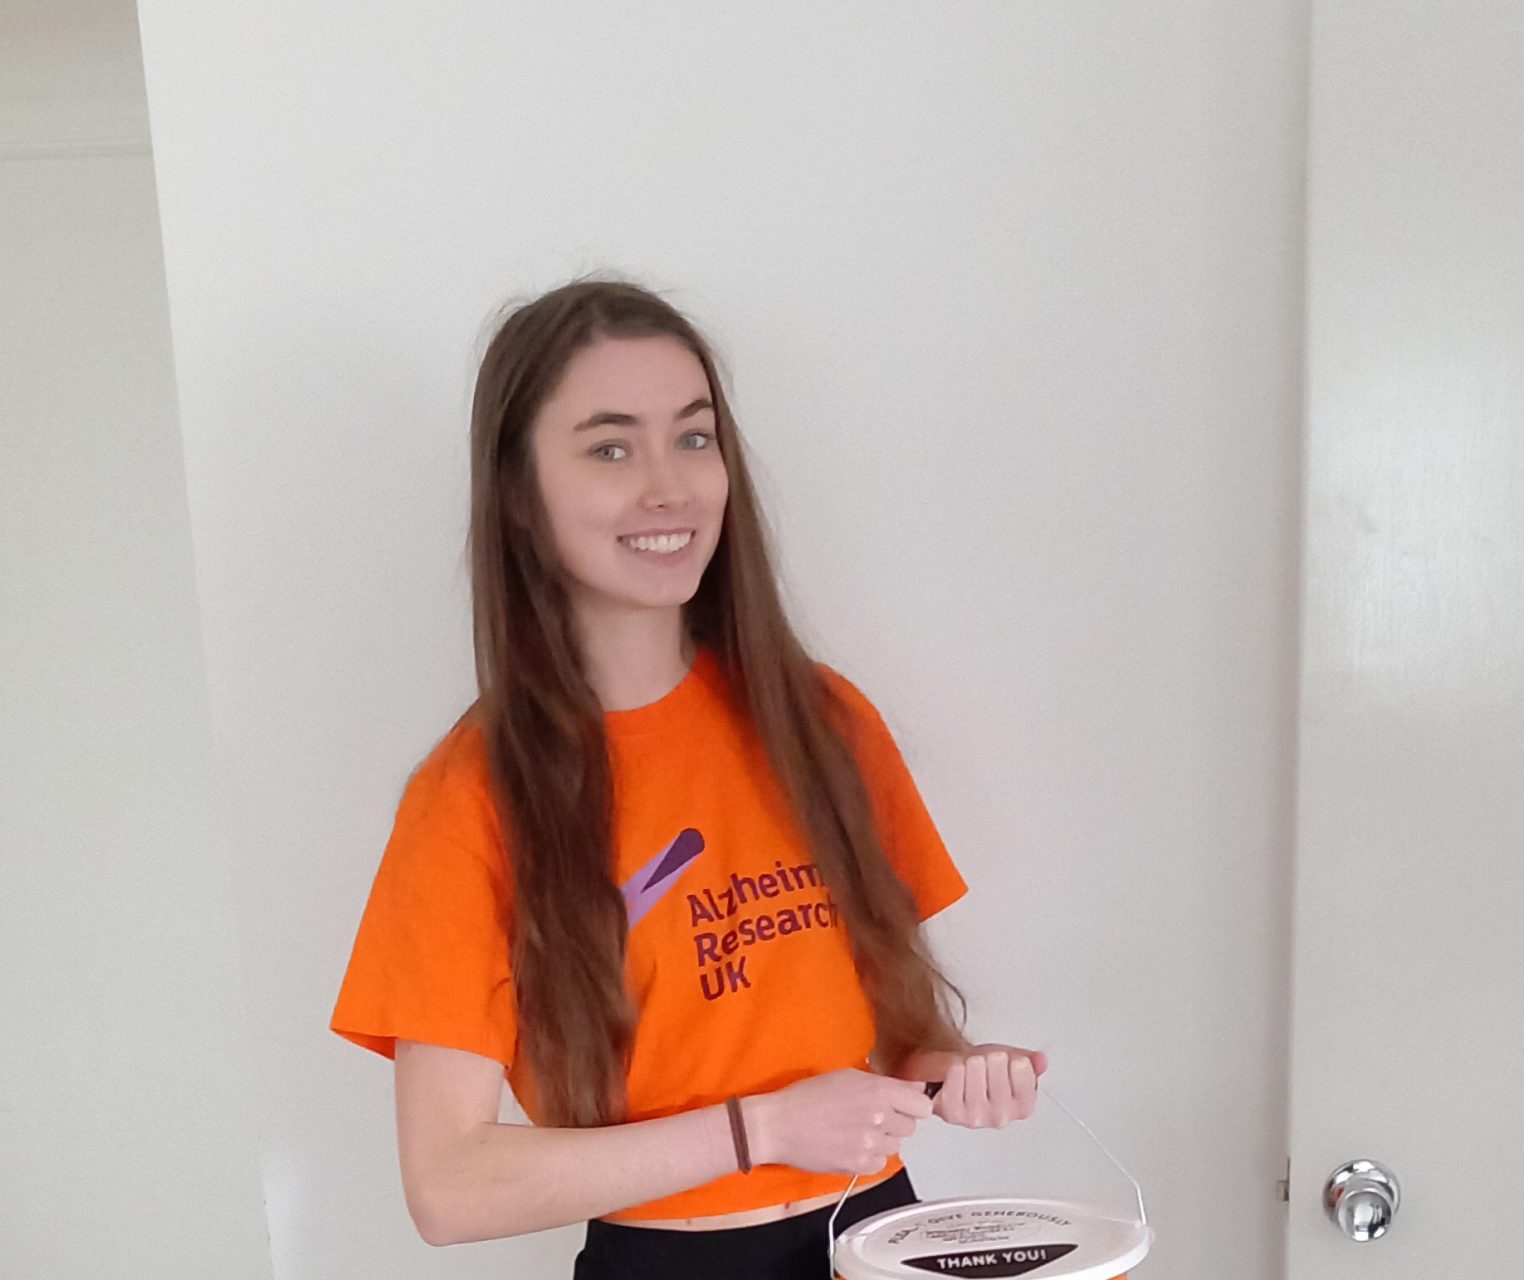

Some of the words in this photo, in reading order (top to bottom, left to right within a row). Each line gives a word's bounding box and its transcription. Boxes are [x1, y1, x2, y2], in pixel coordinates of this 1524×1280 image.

[687, 861, 826, 927] Alzheim
[694, 893, 838, 967] Research
[700, 956, 751, 1001] UK
[971, 1210, 1072, 1226] GENEROUSLY
[937, 1251, 997, 1269] THANK
[1002, 1249, 1047, 1264] YOU!
